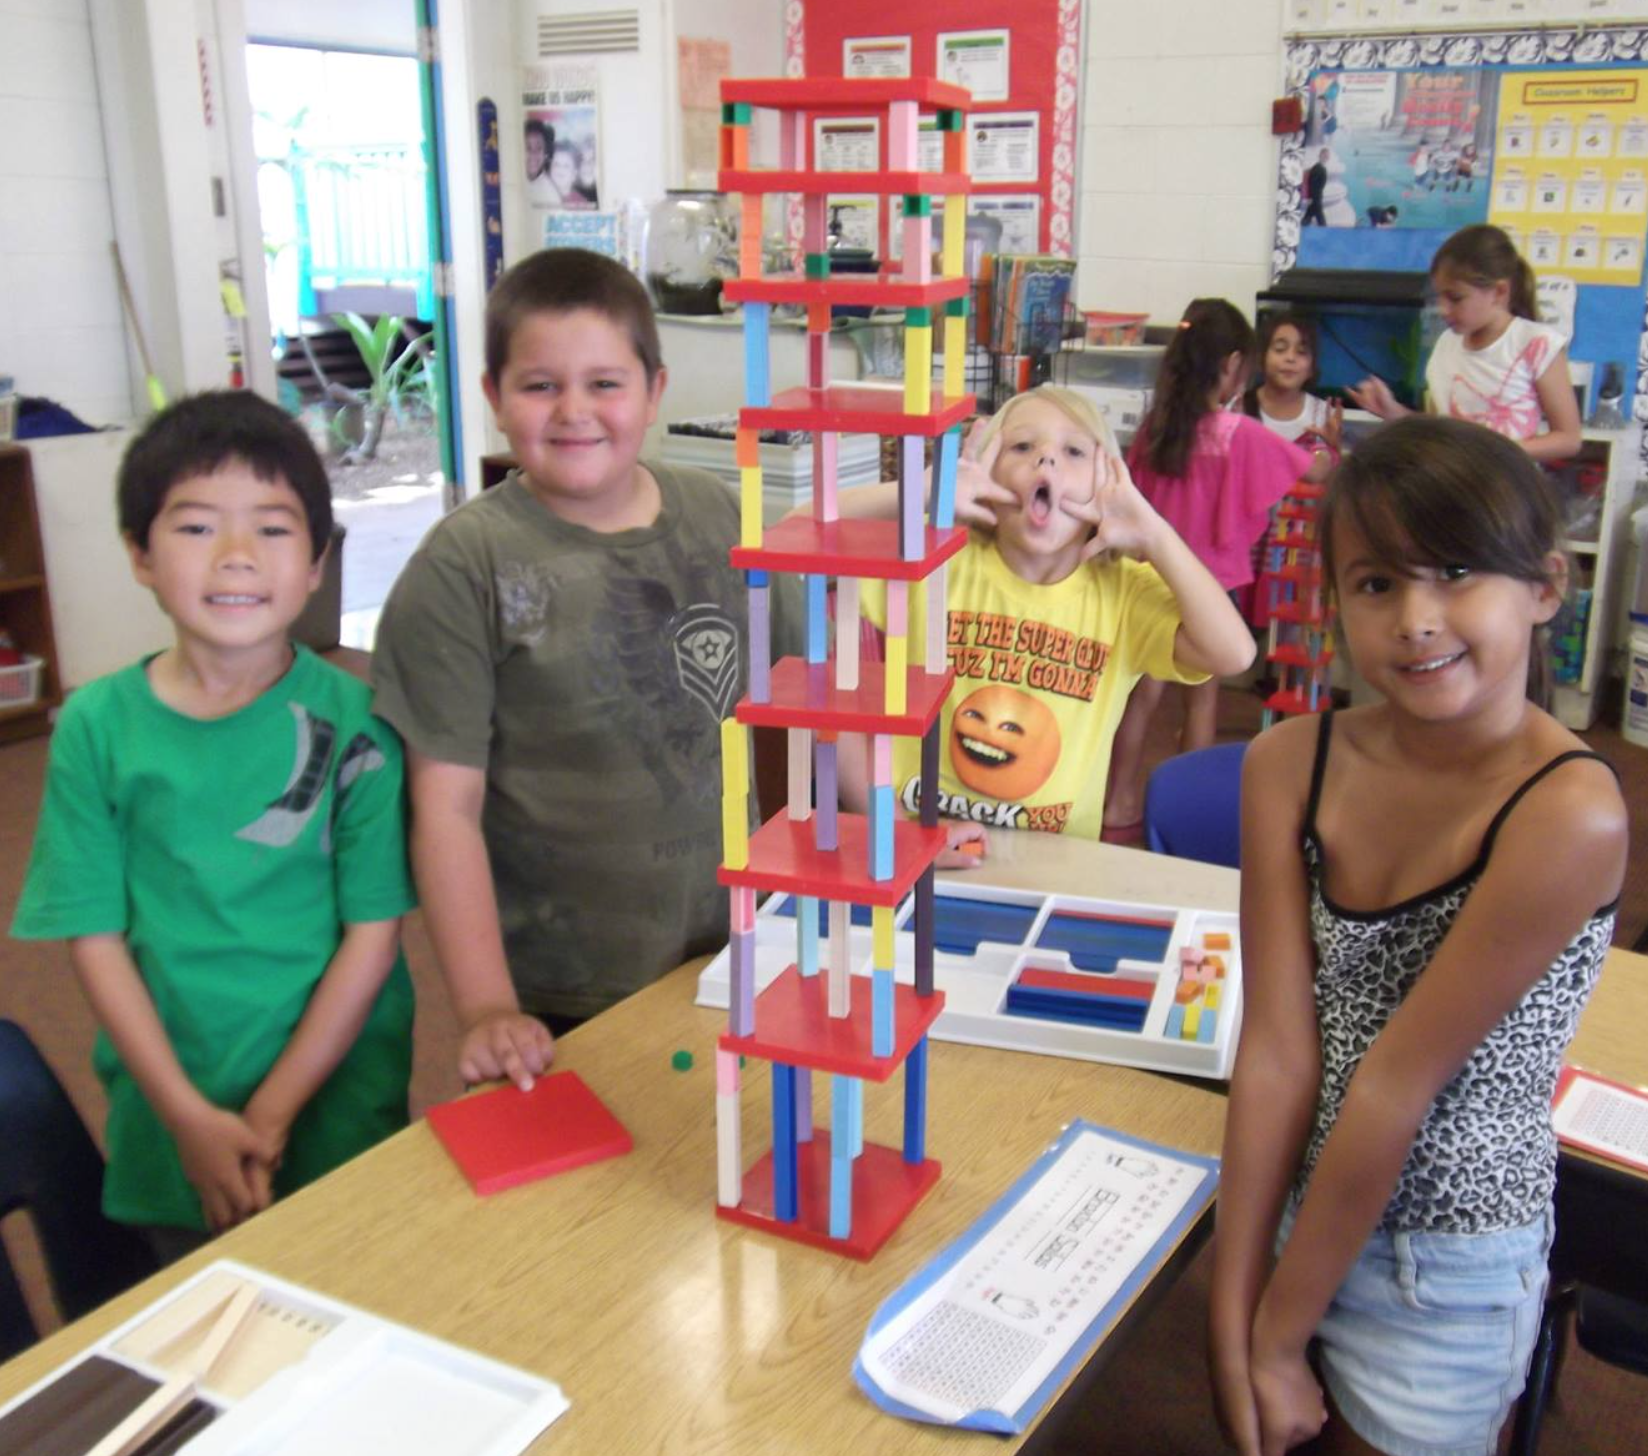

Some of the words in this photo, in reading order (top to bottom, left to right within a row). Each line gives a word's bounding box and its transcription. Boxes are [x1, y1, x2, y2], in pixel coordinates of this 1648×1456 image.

[549, 91, 561, 104] US
[546, 214, 616, 233] ACCEPT
[947, 611, 974, 645] ET
[975, 612, 1017, 651] THE
[1015, 620, 1076, 665] SUPER
[988, 650, 1026, 685] I'M
[1027, 659, 1098, 702] GONNA
[1025, 802, 1074, 825] YOU
